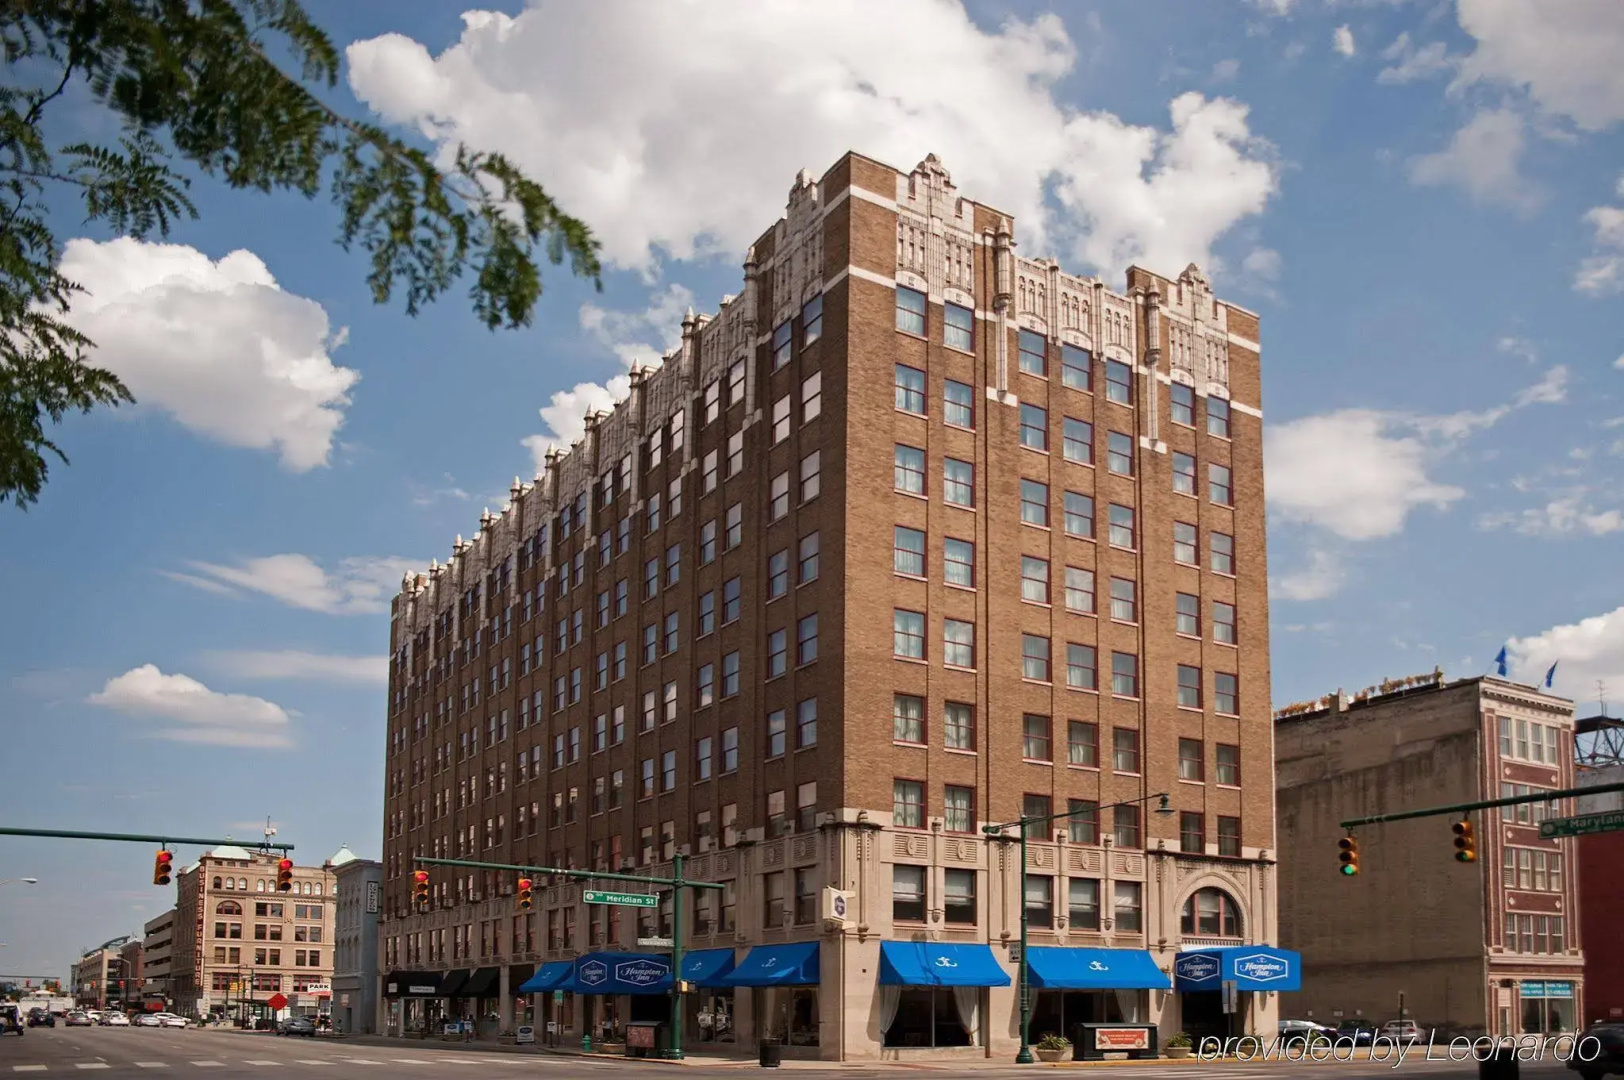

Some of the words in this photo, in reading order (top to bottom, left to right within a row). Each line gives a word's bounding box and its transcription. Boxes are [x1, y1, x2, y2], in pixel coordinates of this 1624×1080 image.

[197, 865, 205, 920] BUSINESS
[606, 895, 642, 904] Meridian
[194, 924, 203, 985] FURNITURE
[1180, 962, 1216, 971] Hampton
[1240, 962, 1283, 972] Hampton
[621, 967, 664, 977] Hampton
